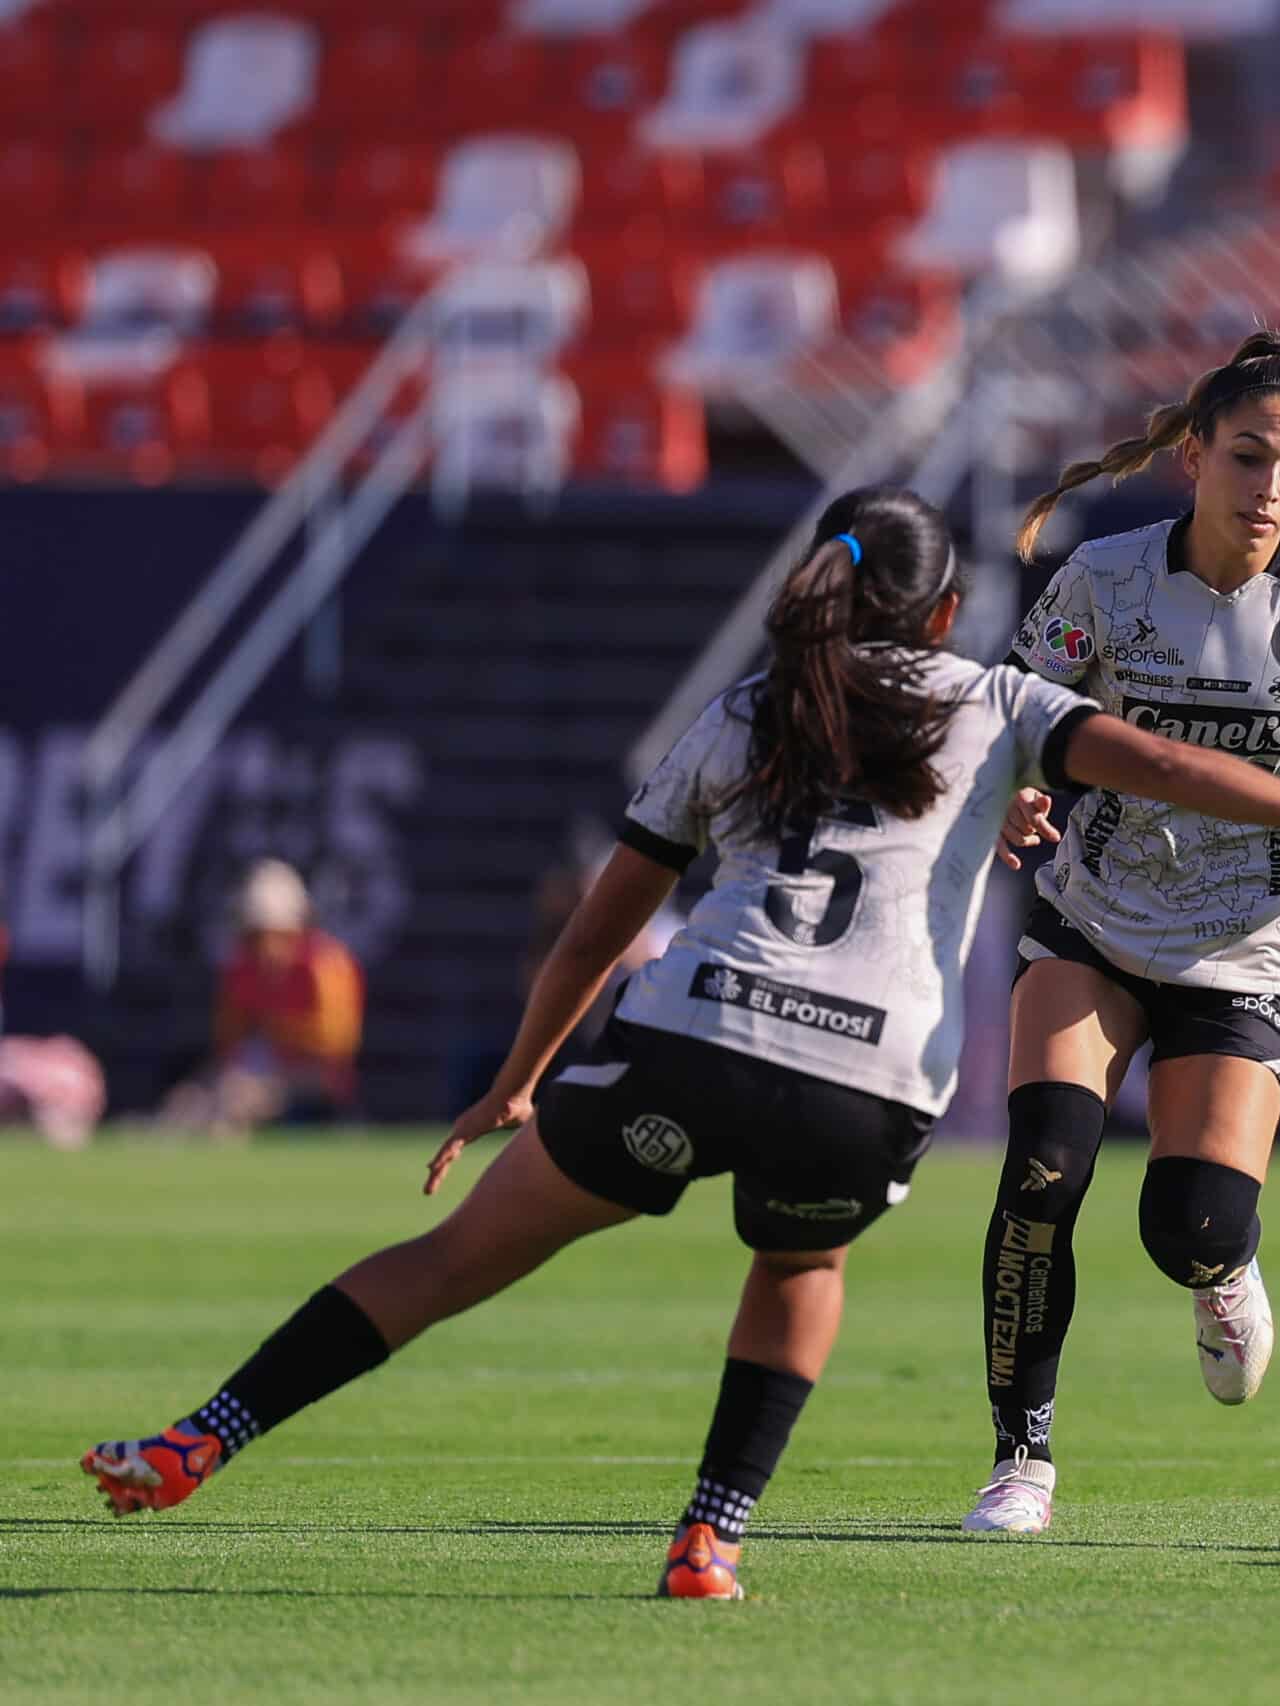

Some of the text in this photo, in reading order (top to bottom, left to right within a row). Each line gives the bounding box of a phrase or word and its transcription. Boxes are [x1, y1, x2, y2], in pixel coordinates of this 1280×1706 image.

[749, 989, 776, 1013] EL
[780, 997, 874, 1040] POTOSÍ
[990, 1250, 1026, 1387] MOCTEZUMA
[1025, 1256, 1052, 1334] Cementos
